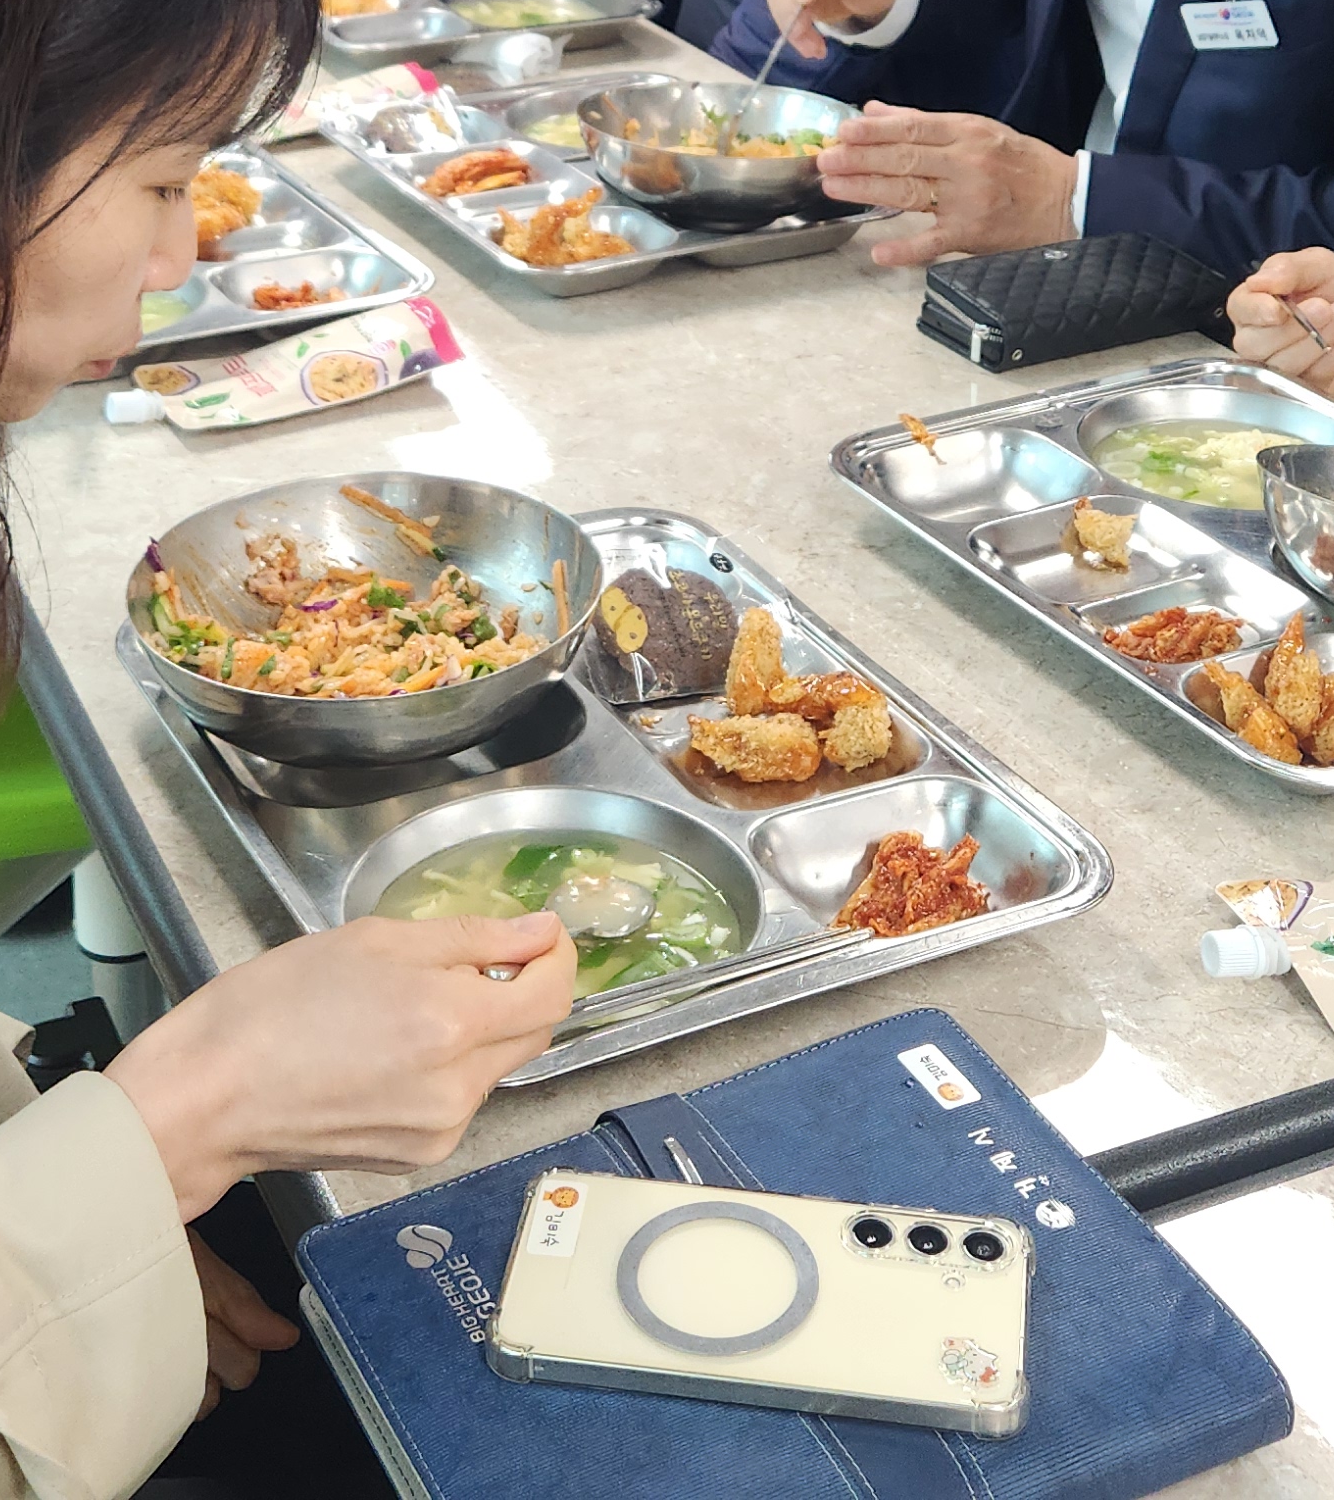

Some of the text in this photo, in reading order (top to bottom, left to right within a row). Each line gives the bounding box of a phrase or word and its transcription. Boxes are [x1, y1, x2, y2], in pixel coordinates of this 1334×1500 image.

[430, 1268, 486, 1343] BIG HEART
[446, 1253, 496, 1320] GEOJE
